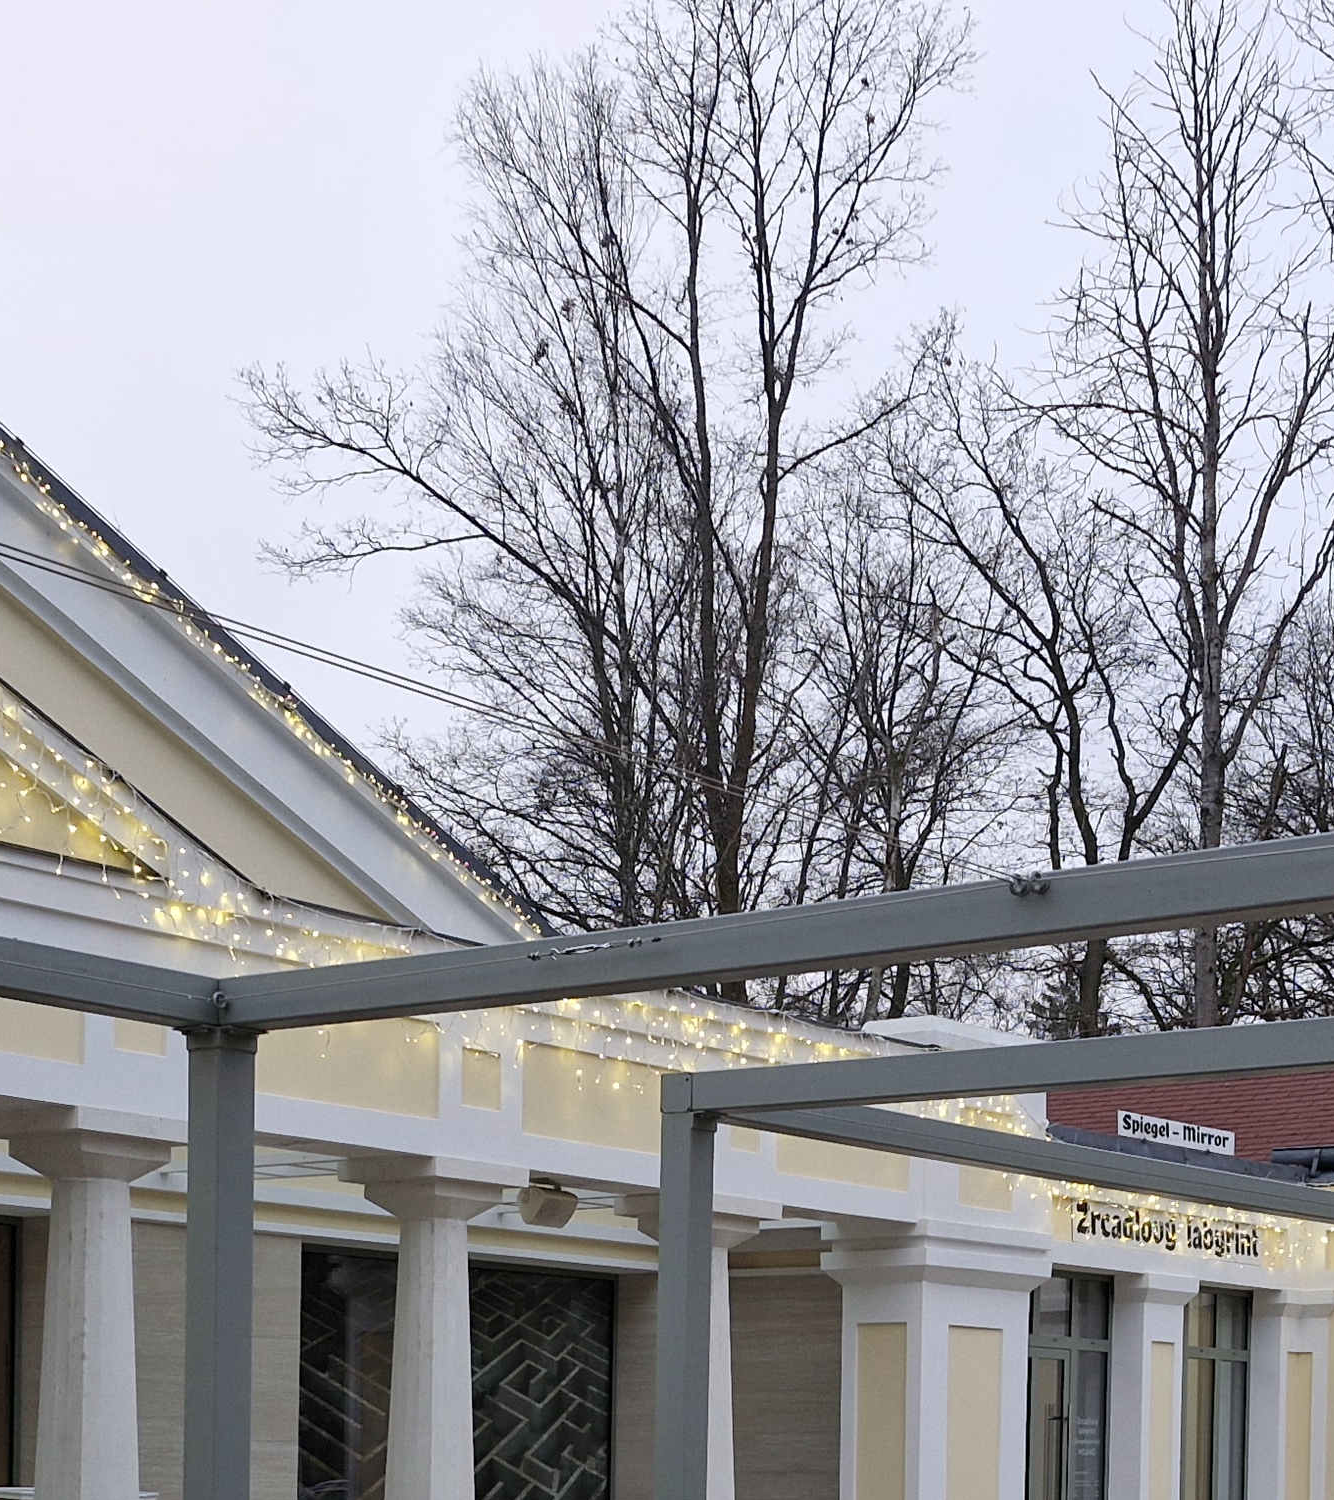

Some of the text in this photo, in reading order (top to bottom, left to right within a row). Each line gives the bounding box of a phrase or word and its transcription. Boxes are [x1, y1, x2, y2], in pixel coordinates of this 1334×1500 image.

[1122, 1114, 1169, 1138] Spiegel
[1183, 1125, 1229, 1147] Mirror
[1186, 1217, 1259, 1258] labyrint
